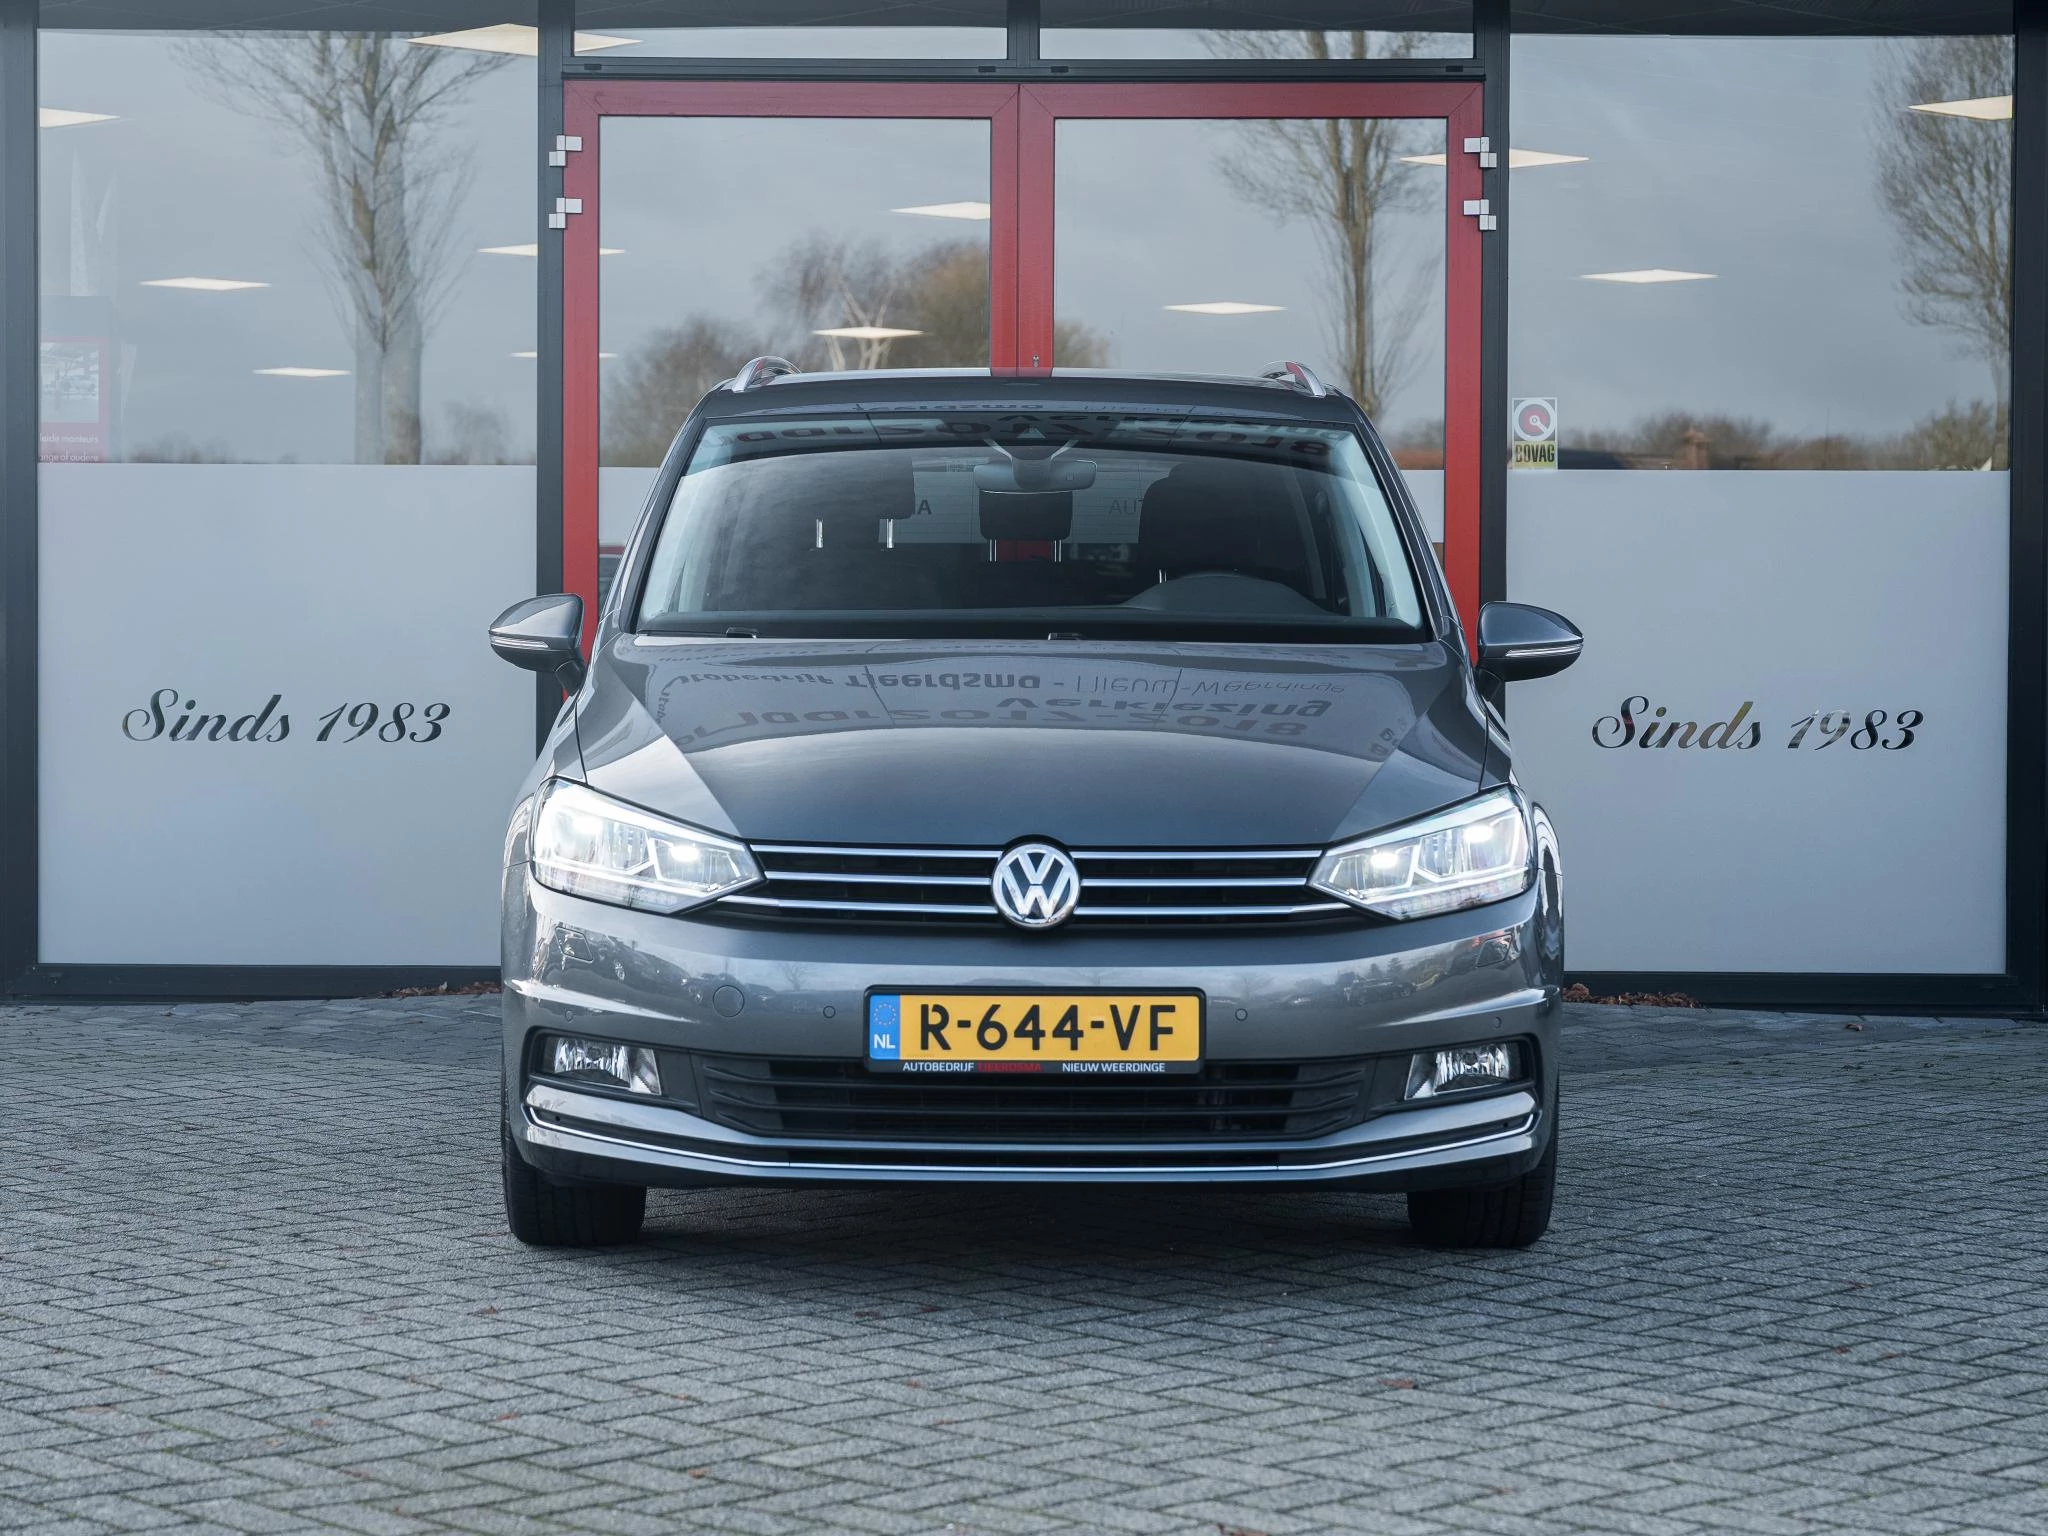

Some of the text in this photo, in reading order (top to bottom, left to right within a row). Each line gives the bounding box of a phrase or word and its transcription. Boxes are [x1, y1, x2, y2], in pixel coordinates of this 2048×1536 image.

[1515, 443, 1555, 463] BOVAG
[122, 688, 451, 744] Sinds 1983
[1592, 695, 1924, 751] Sinds 1983
[996, 846, 1076, 924] VW
[873, 1034, 896, 1049] NL
[920, 1003, 1177, 1051] R-644-VF
[902, 1062, 975, 1073] AUTOBEDRIJF
[1061, 1062, 1099, 1073] NIEUW
[1100, 1062, 1166, 1073] WEERDINGE
